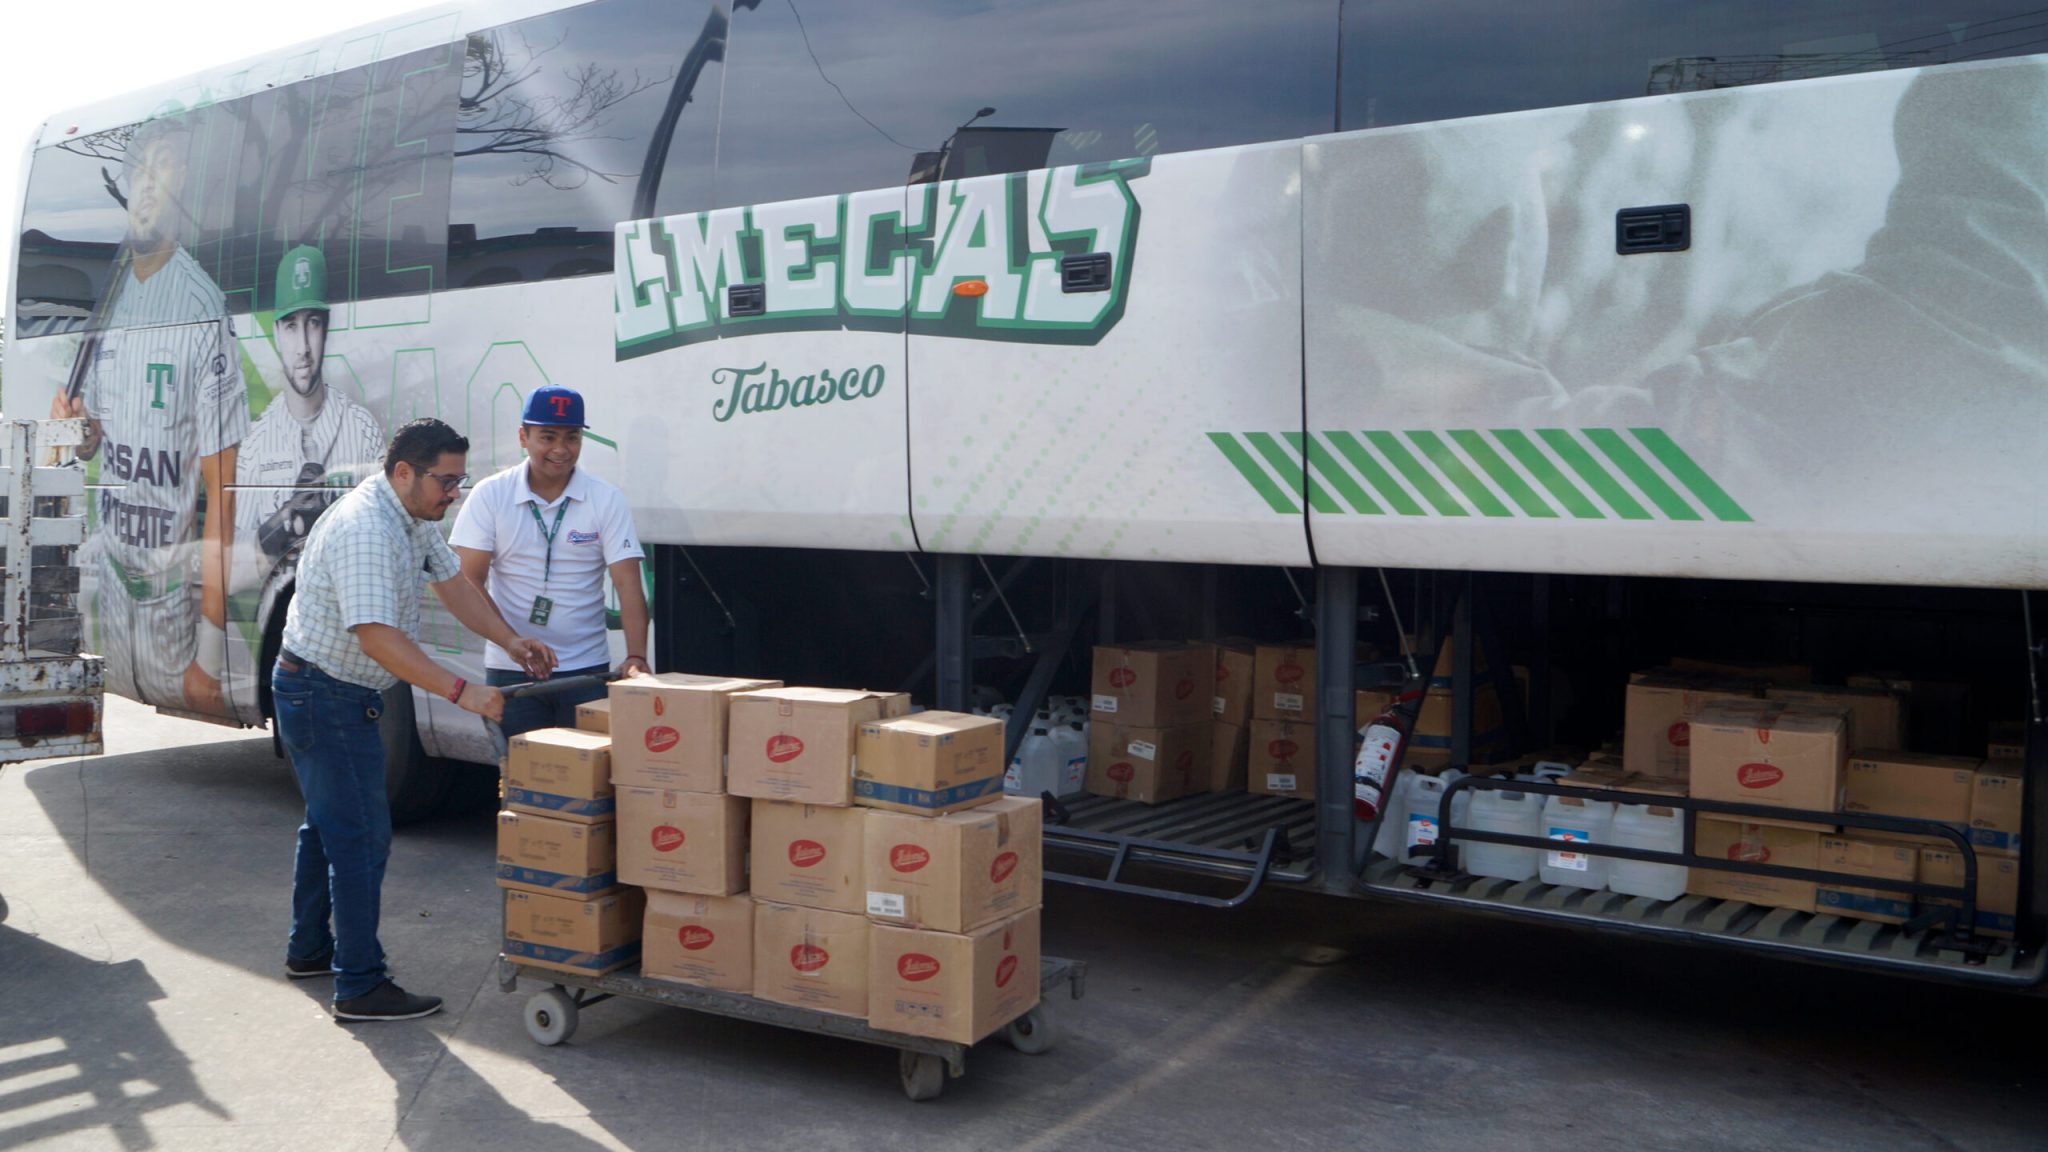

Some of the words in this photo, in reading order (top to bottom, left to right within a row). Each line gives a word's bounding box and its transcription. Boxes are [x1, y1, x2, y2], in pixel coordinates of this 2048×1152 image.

[146, 363, 175, 410] T
[550, 396, 571, 417] T
[711, 360, 886, 423] Tabasco
